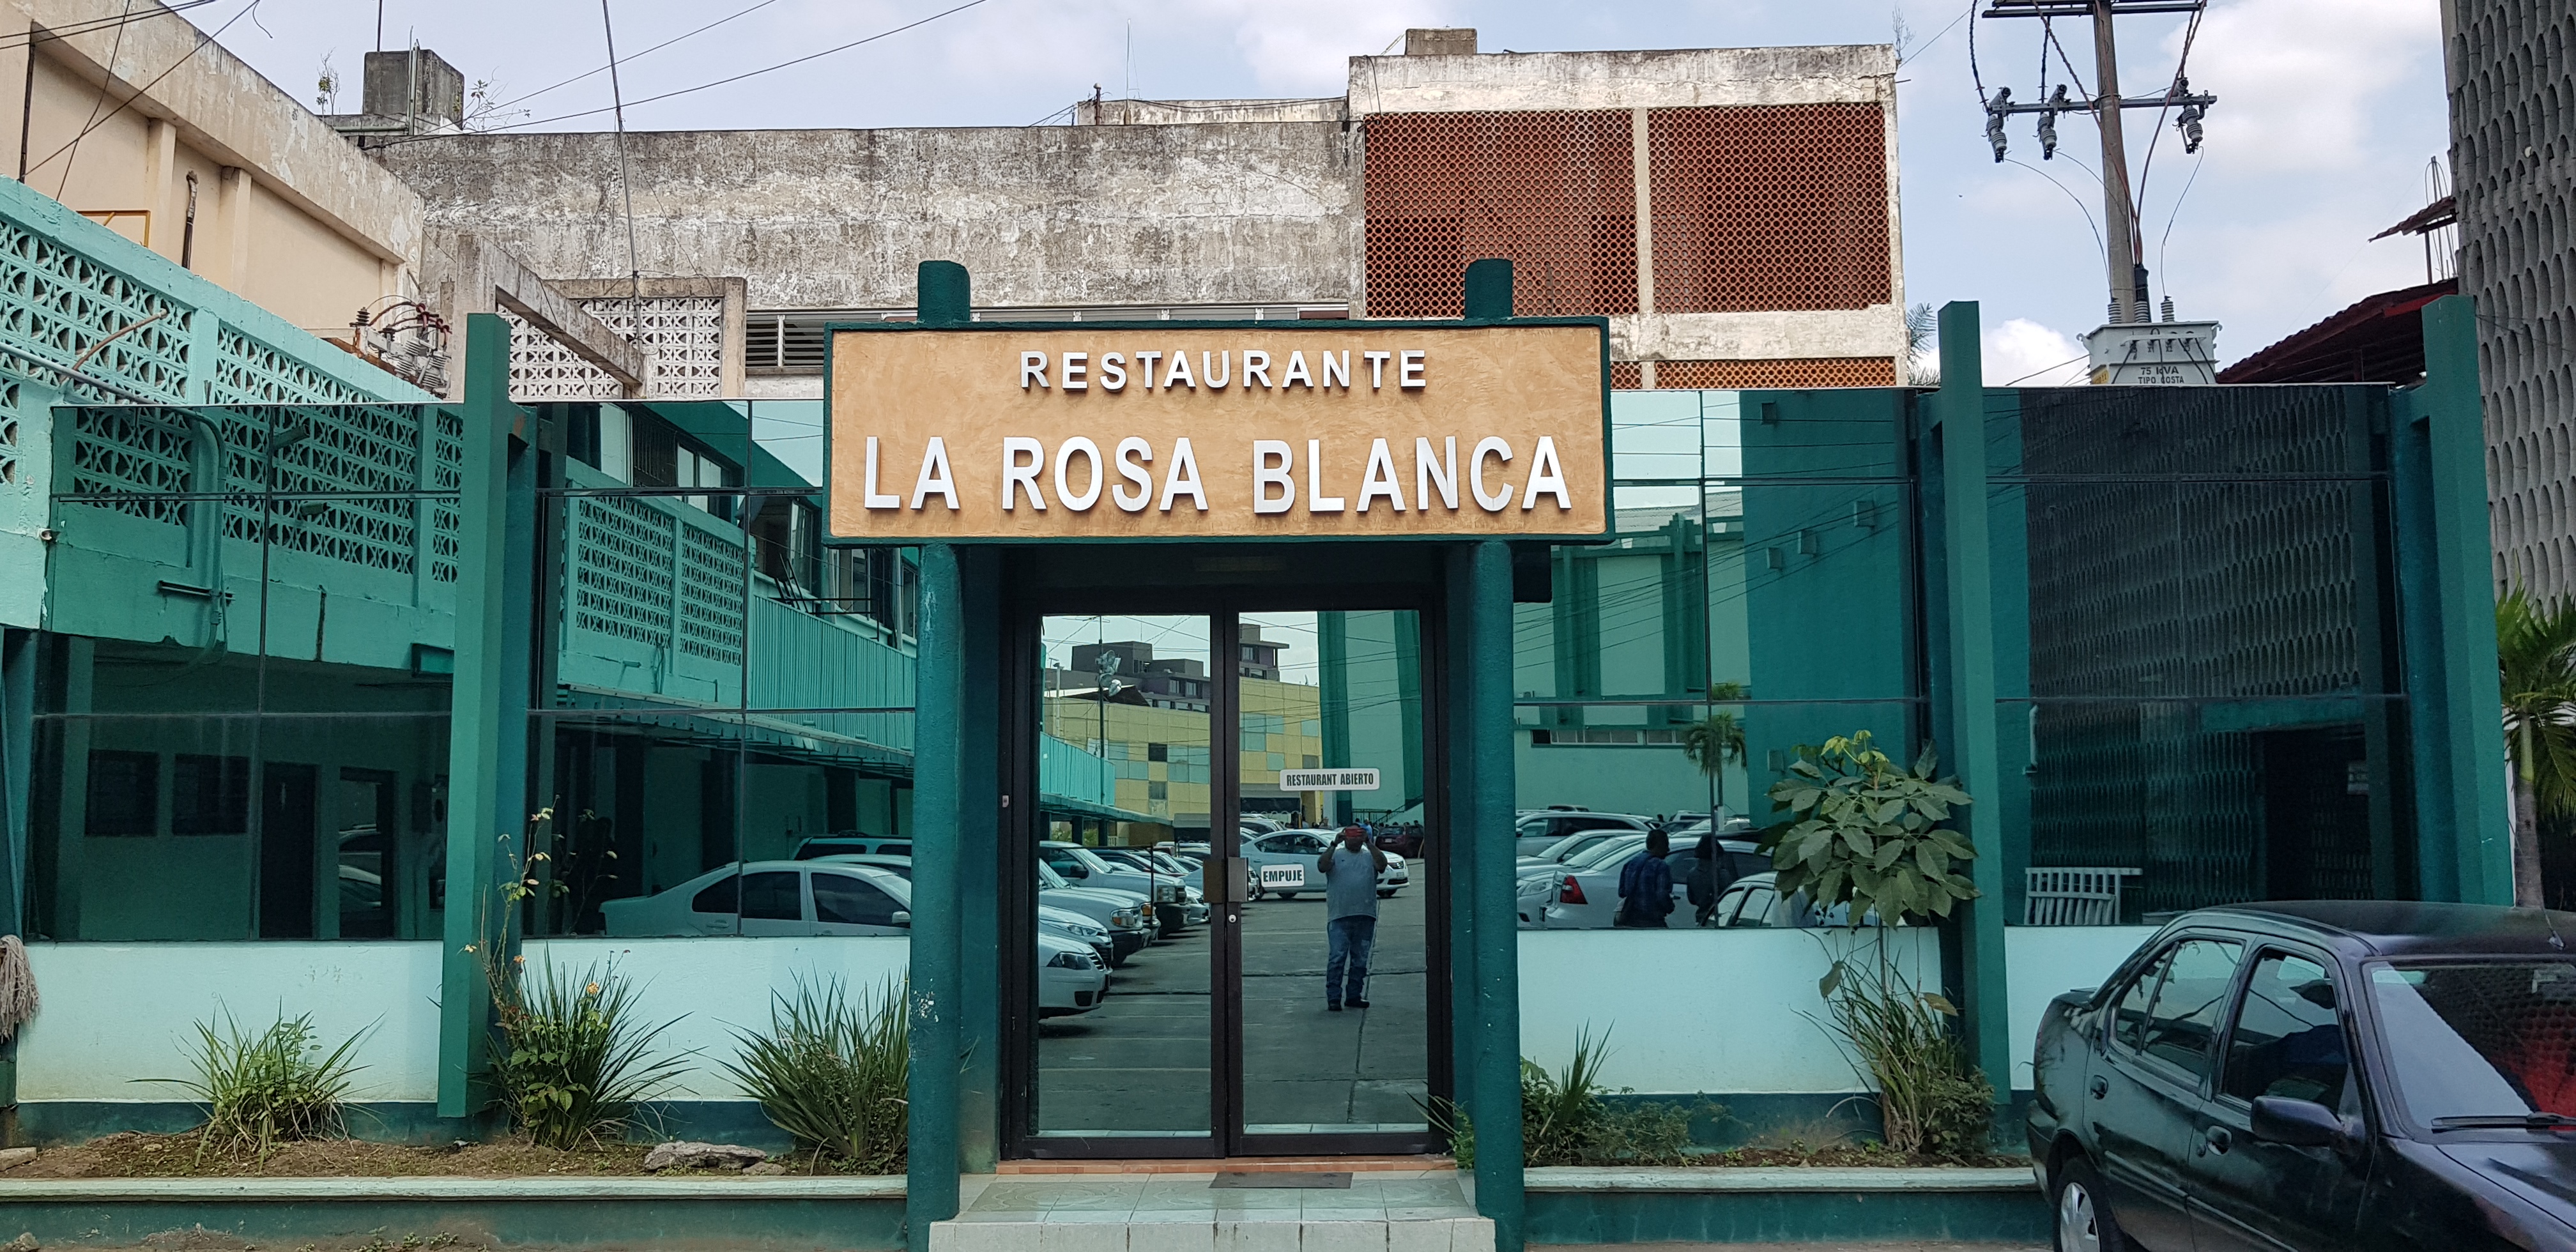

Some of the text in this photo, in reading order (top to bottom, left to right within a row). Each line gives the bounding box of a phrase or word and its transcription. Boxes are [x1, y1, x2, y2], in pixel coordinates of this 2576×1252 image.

[1020, 349, 1427, 391] RESTAURANTE
[2161, 376, 2184, 384] COSTA
[863, 436, 1572, 514] LA ROSA BLANCA
[1286, 773, 1374, 786] RESTAURANT ABIERTO
[1262, 869, 1303, 882] EMPUJE
